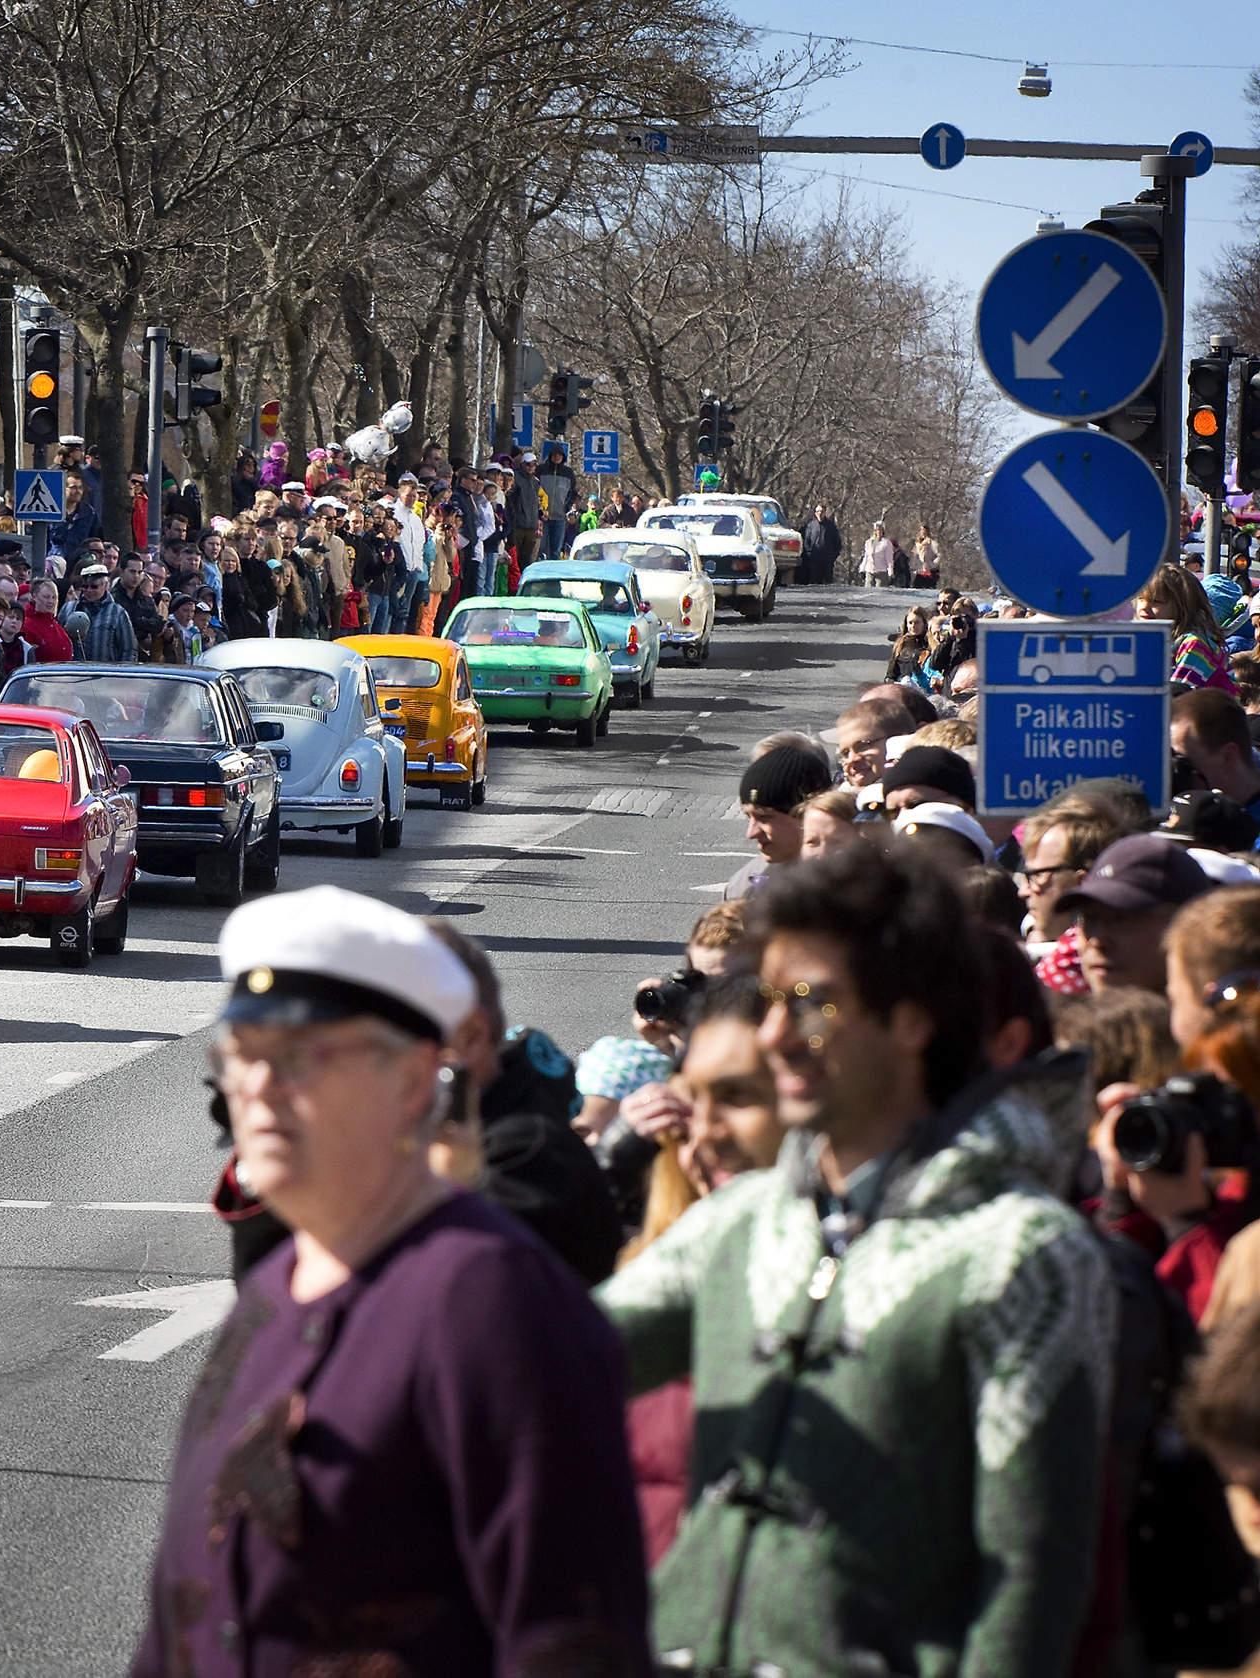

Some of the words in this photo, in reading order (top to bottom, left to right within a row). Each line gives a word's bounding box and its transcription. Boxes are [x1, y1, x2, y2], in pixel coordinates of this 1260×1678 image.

[1016, 703, 1136, 729] Paikallis-
[1024, 732, 1126, 759] liikenne
[442, 798, 466, 806] FIAT
